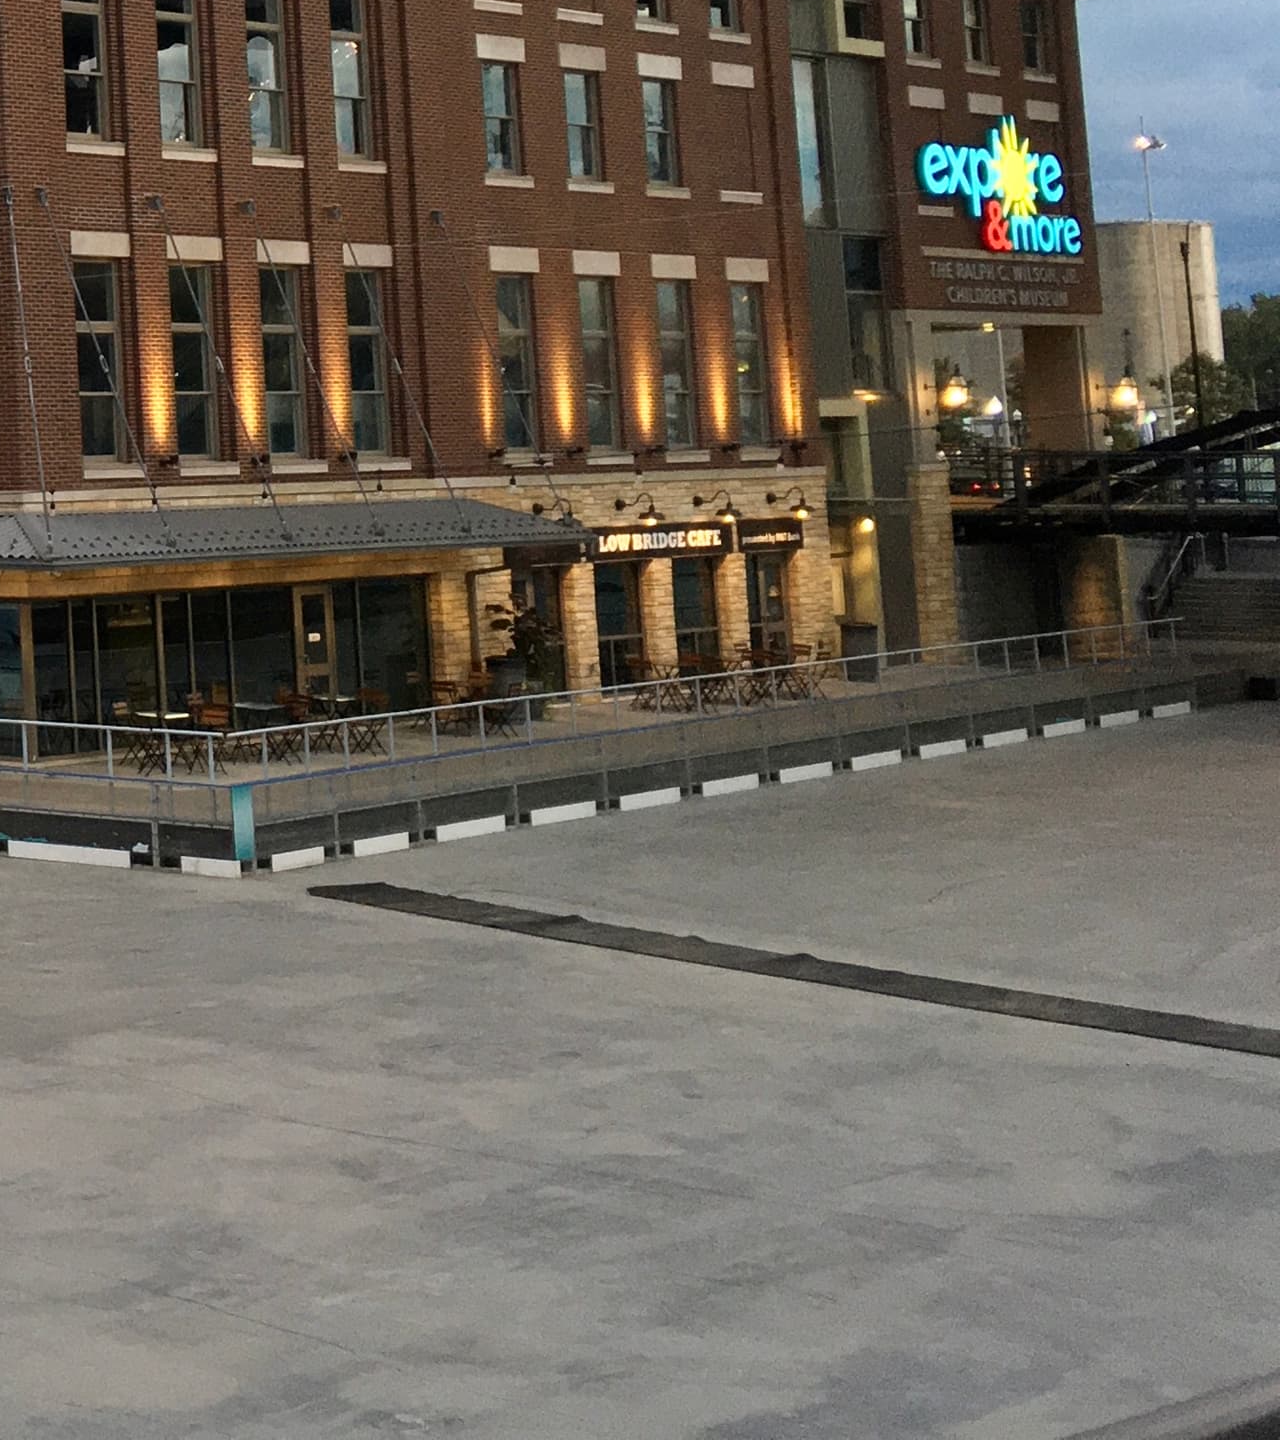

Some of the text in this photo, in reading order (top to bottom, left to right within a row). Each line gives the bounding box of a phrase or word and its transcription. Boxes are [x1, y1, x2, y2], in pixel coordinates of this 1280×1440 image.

[930, 261, 953, 279] THE
[956, 262, 995, 281] RALPH
[947, 286, 1069, 307] CHILDREN'S MUSEUM
[599, 529, 721, 553] LOW BRIDGE CAFE
